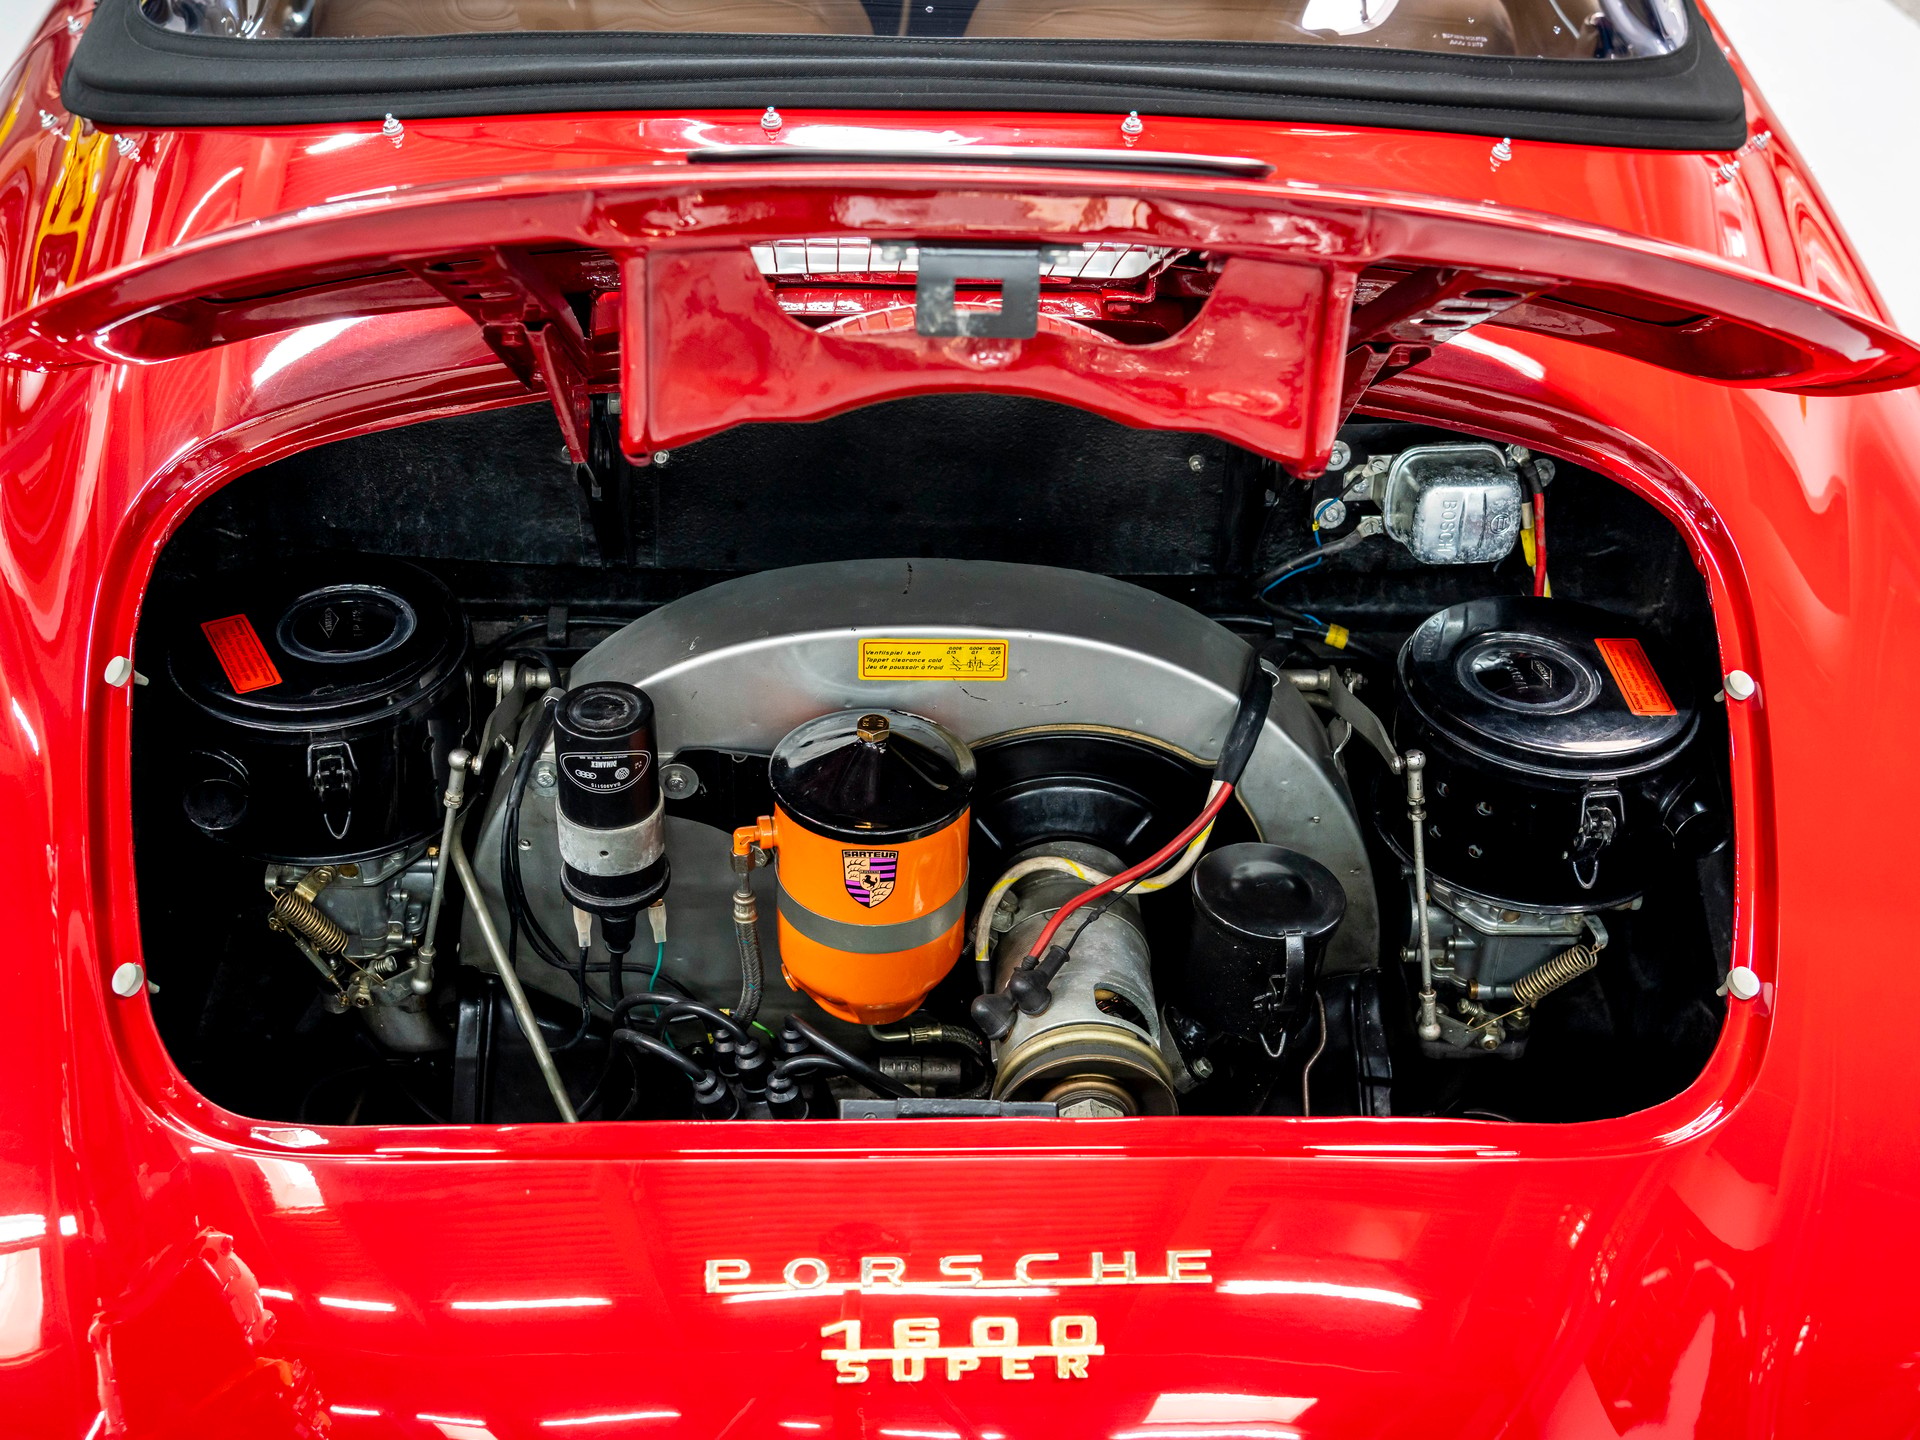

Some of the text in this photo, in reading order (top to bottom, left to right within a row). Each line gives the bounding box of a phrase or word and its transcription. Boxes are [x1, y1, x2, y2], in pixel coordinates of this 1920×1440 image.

[1437, 499, 1459, 553] BOSCH
[705, 1249, 1213, 1293] PORSCHE
[820, 1315, 1098, 1351] 1600
[836, 1355, 1090, 1384] SUPER
